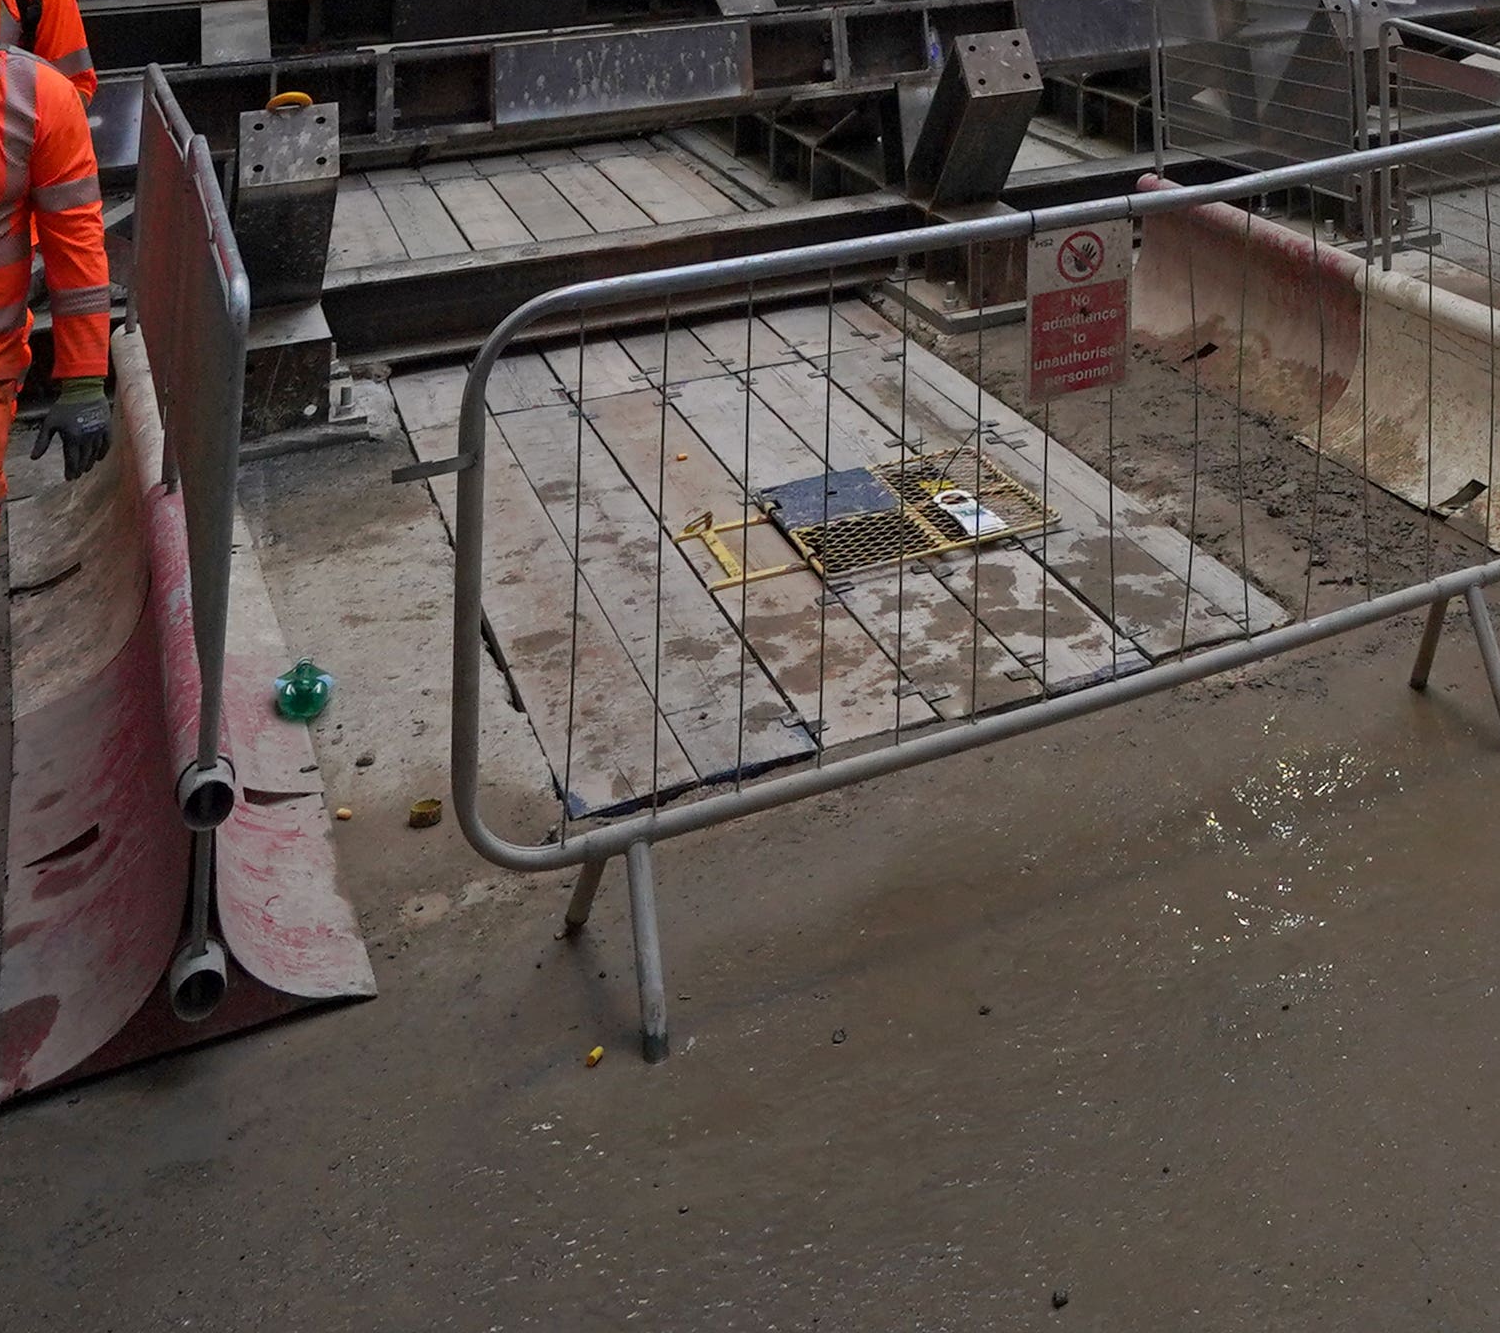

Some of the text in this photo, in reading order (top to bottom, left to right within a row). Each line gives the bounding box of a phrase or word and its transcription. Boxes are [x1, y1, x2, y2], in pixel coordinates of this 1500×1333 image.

[1071, 293, 1090, 308] No
[1042, 307, 1118, 332] admittance
[1073, 333, 1087, 344] to
[1033, 342, 1124, 371] unauthorised
[1044, 362, 1114, 388] personnel
